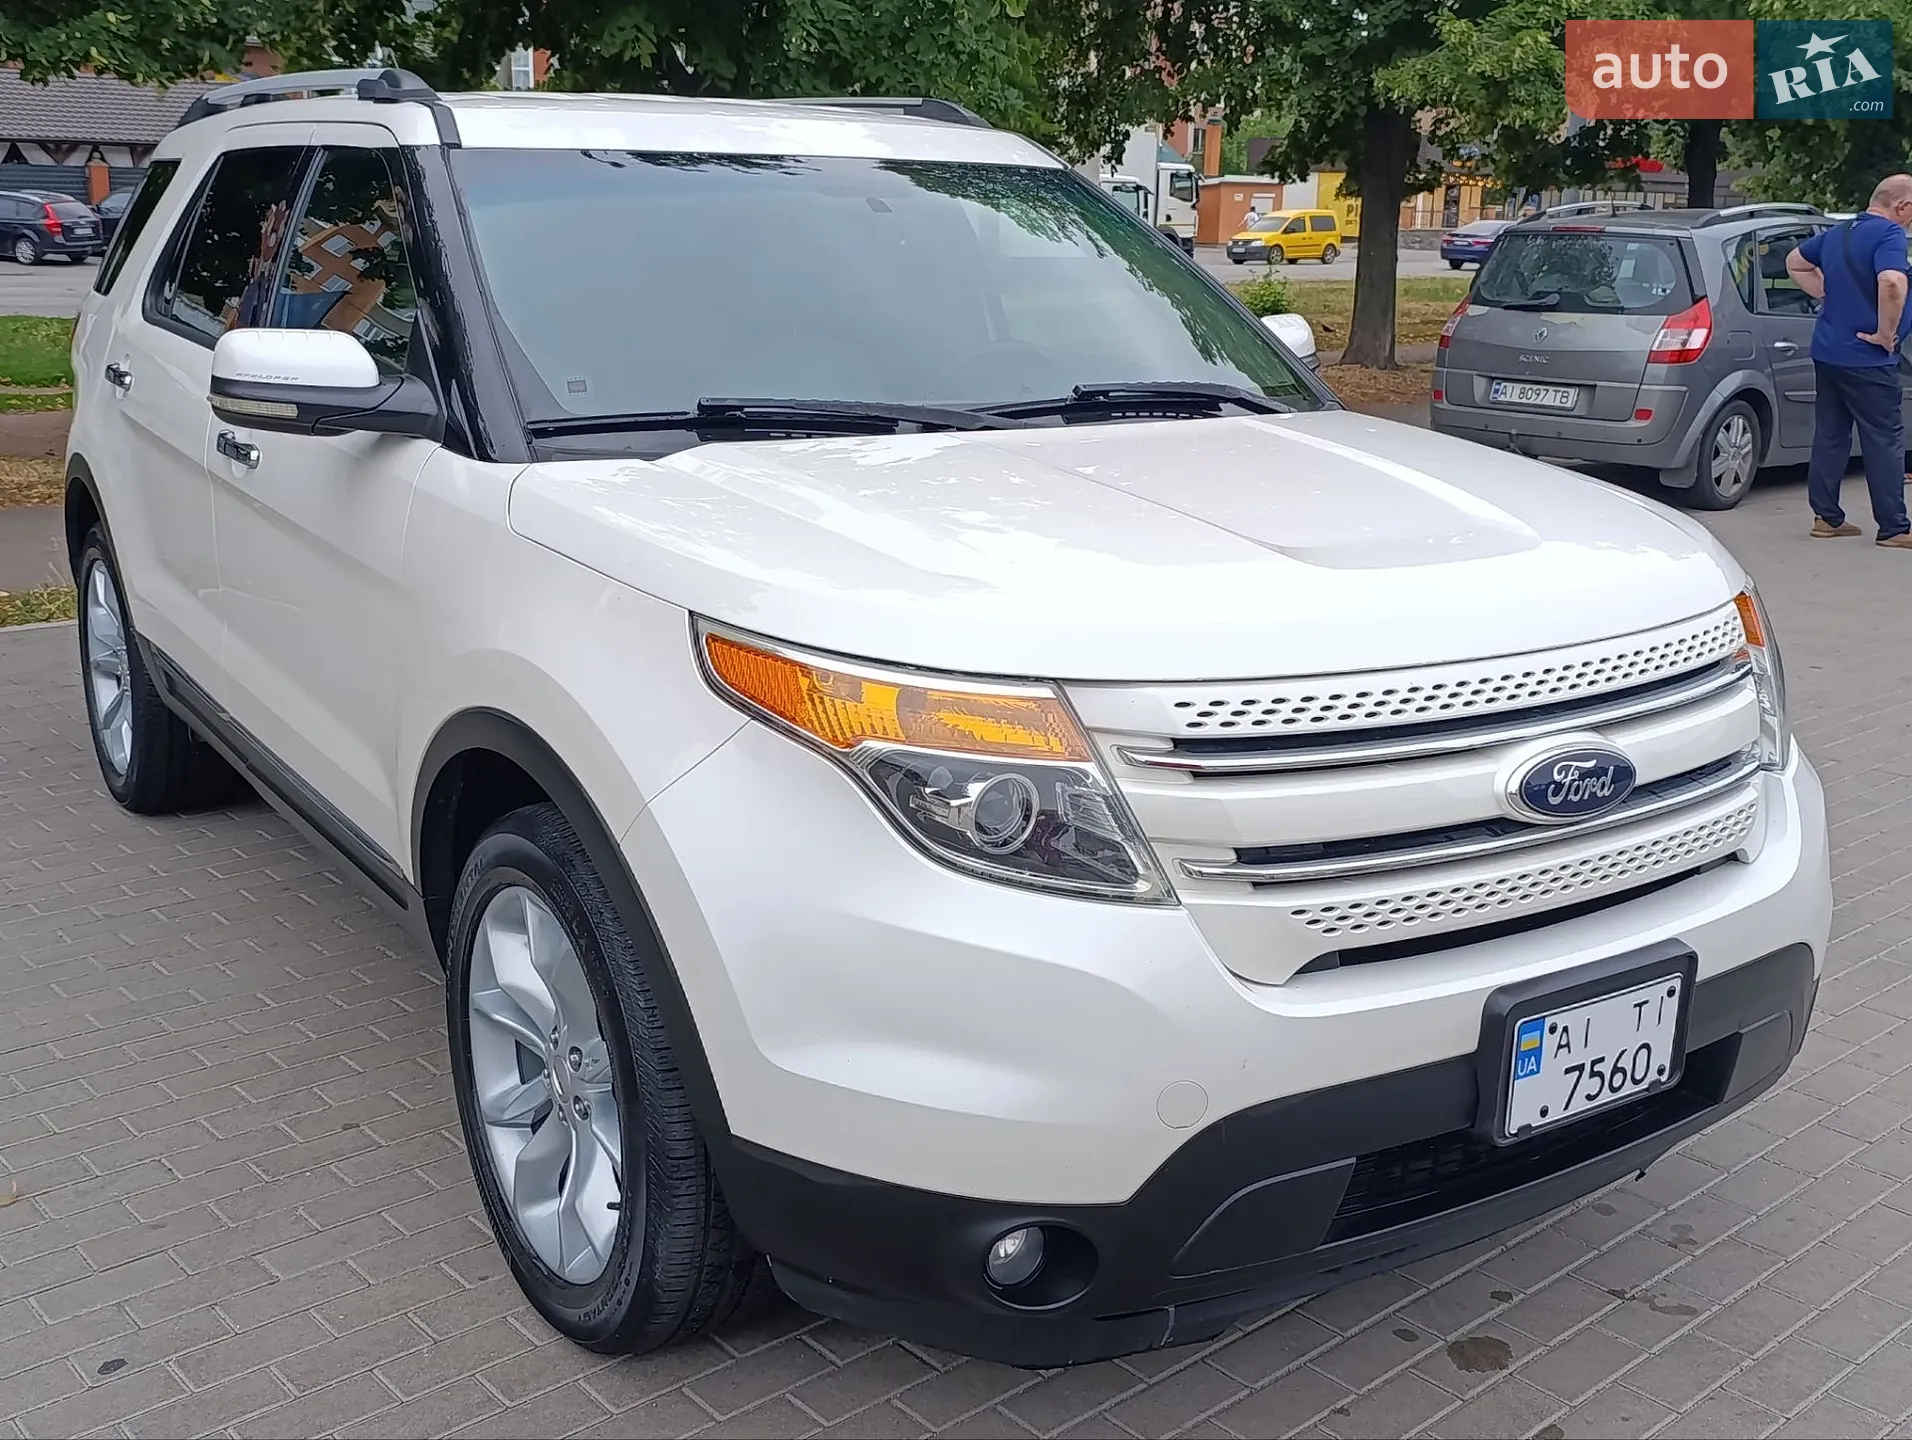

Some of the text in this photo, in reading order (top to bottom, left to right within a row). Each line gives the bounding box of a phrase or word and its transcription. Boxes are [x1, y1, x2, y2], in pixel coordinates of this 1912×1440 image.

[1499, 385, 1570, 404] AI 8097 TB
[1547, 759, 1615, 805] Ford
[1553, 995, 1664, 1059] AI TI
[1517, 1056, 1538, 1077] UA
[1562, 1042, 1652, 1112] 7560
